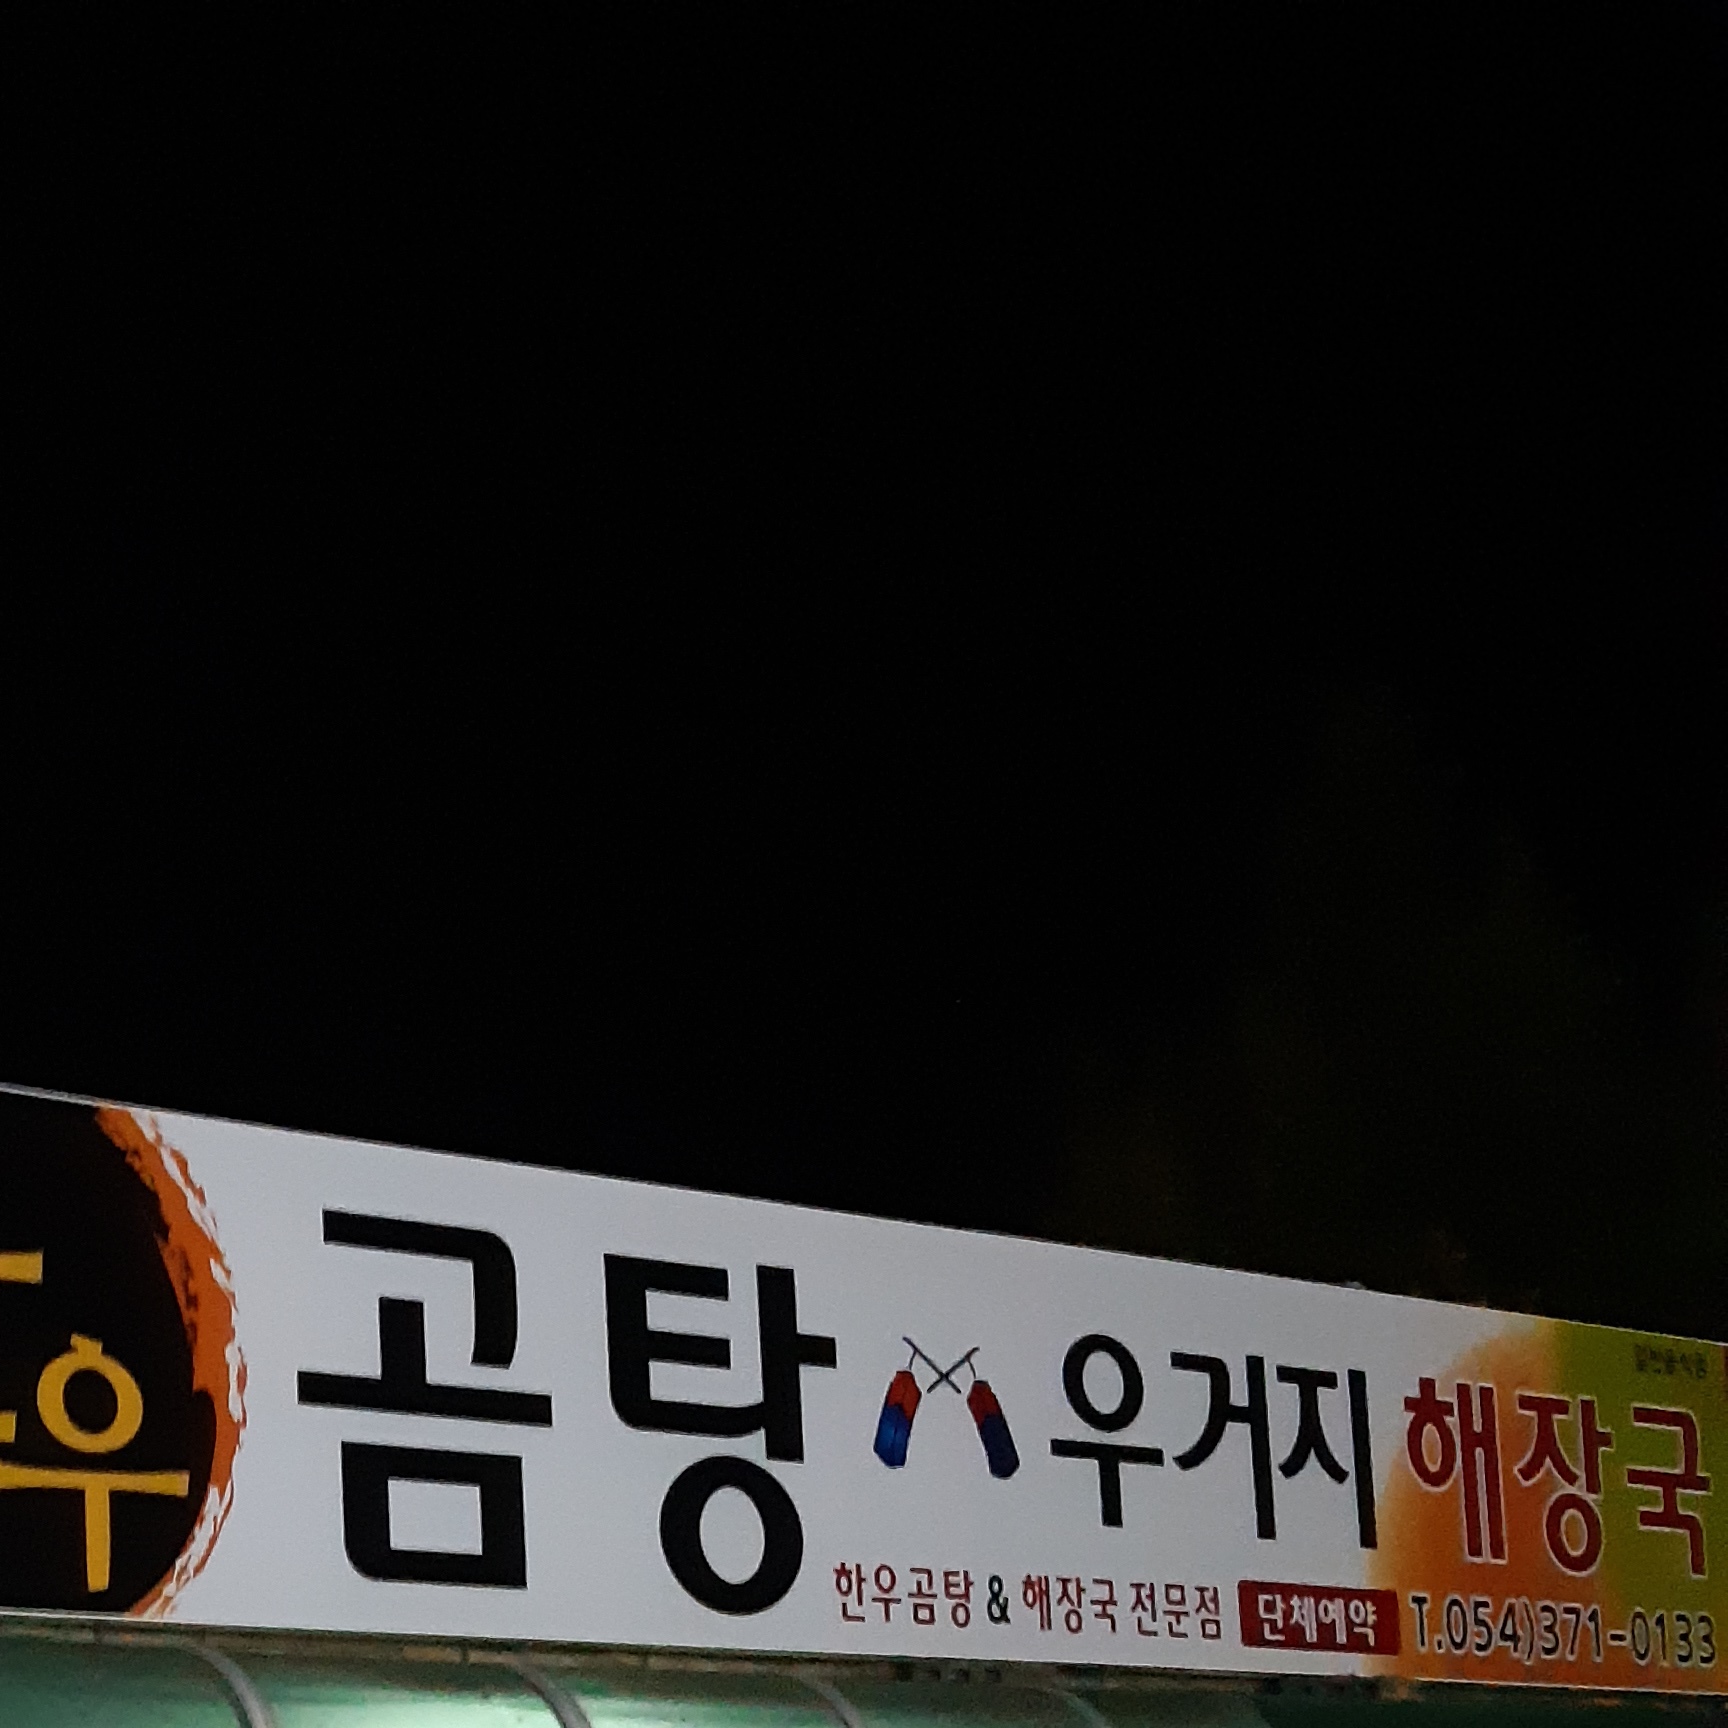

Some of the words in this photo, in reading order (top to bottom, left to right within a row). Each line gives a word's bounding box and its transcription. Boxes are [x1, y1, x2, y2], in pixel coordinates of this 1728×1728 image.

[298, 1207, 837, 1615] 곰탕
[1050, 1334, 1377, 1549] 우거지
[1403, 1375, 1709, 1579] 해장국
[833, 1561, 973, 1628] 한우곰탕
[987, 1575, 1010, 1624] &
[1022, 1573, 1118, 1634] 해장국
[1130, 1581, 1222, 1640] 전문점
[1257, 1593, 1377, 1646] 단체예약
